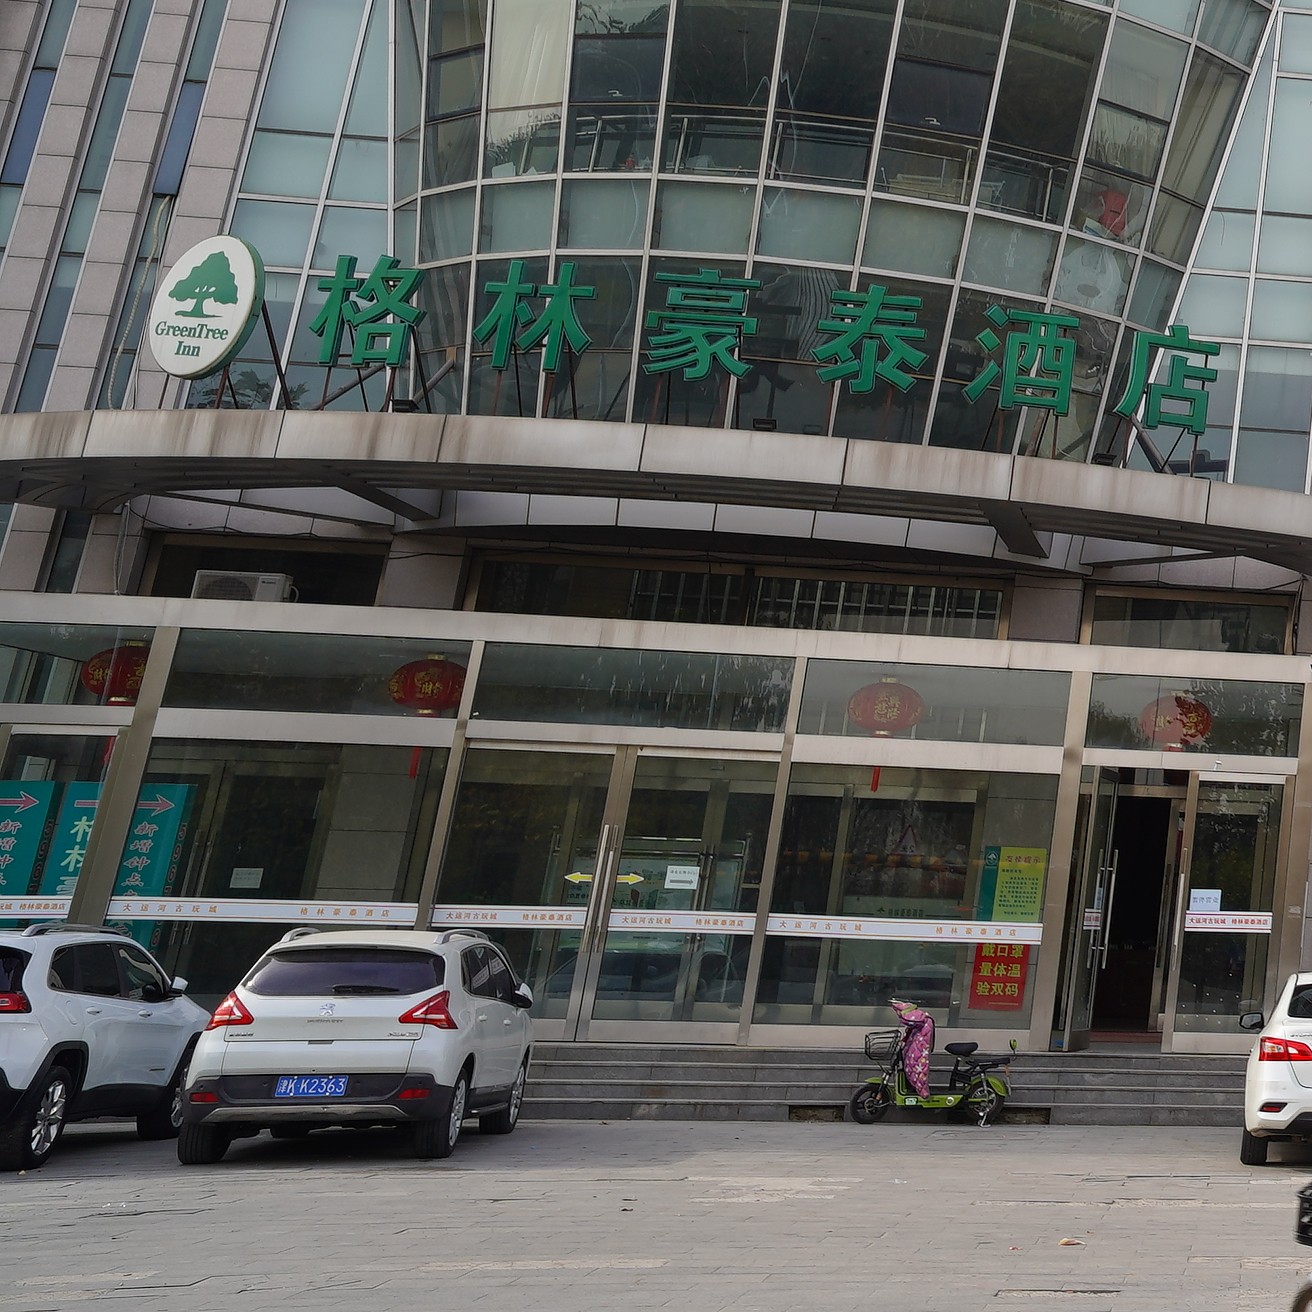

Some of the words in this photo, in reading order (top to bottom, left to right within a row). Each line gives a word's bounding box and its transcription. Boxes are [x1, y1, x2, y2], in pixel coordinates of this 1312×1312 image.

[155, 321, 229, 340] GreenTree
[175, 341, 200, 357] Inn
[310, 254, 1220, 436] 格林豪泰酒店
[123, 903, 218, 913] 大运河古玩城
[300, 907, 390, 917] 格林豪泰酒店
[779, 920, 863, 931] 大运河古玩城
[982, 944, 1024, 958] 戴口罩
[979, 963, 1021, 977] 量体温
[976, 982, 1019, 997] 验双码
